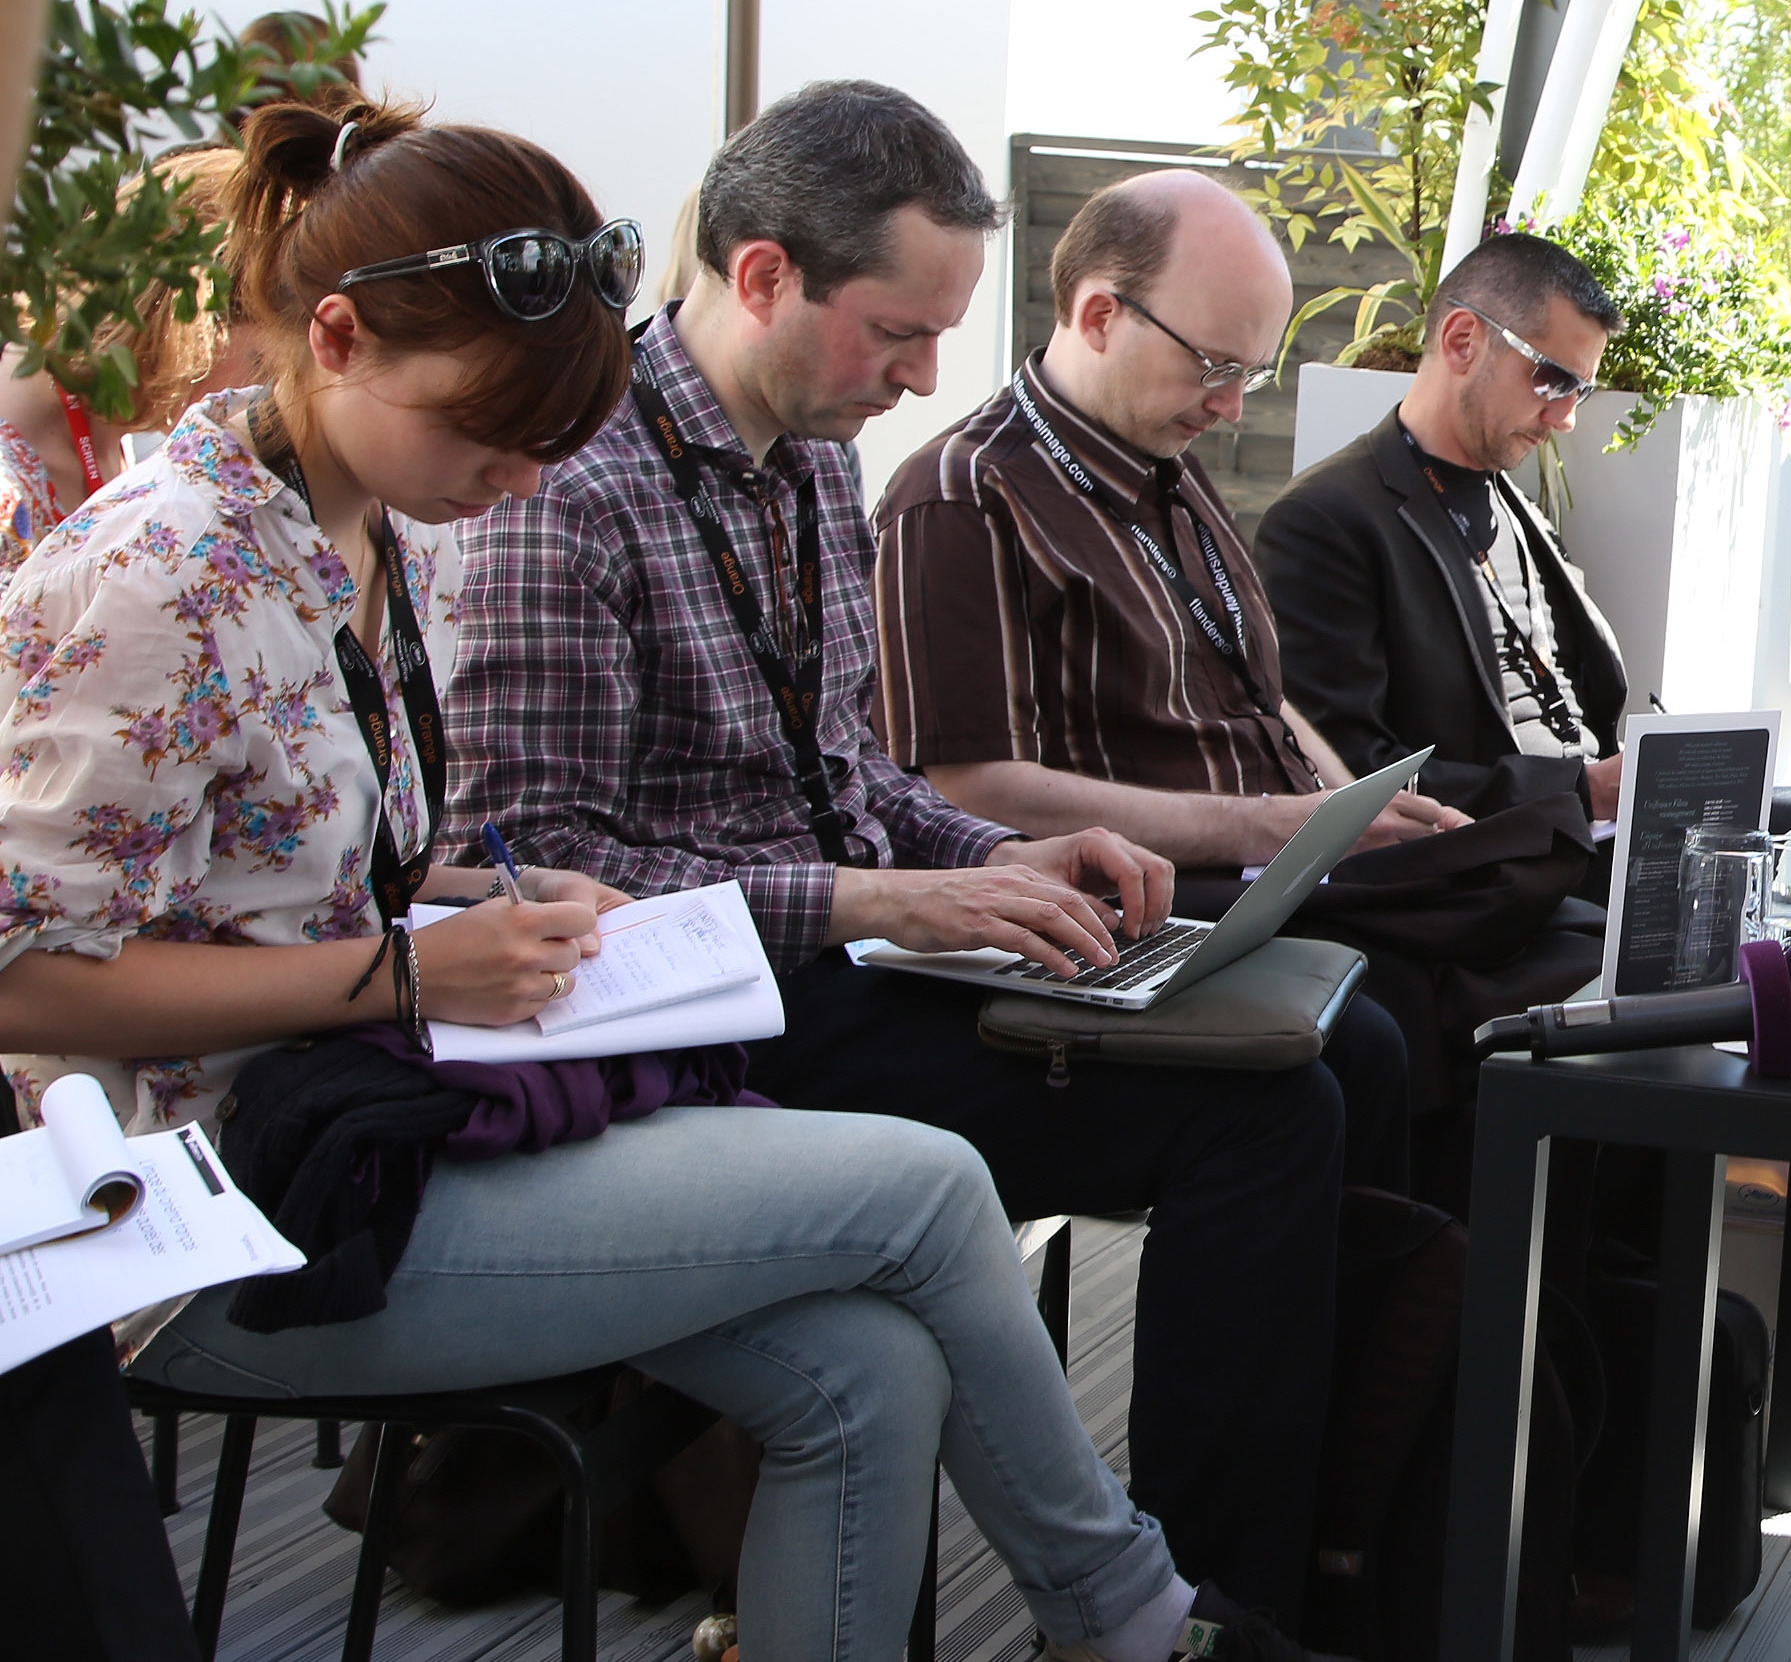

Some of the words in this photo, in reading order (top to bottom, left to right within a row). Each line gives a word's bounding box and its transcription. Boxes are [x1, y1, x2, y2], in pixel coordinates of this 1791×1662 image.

[79, 436, 99, 480] SCREEN
[656, 415, 683, 459] Orange
[387, 546, 404, 598] Orange
[720, 551, 745, 595] Orange
[367, 711, 388, 767] Orange
[418, 713, 436, 765] Orange
